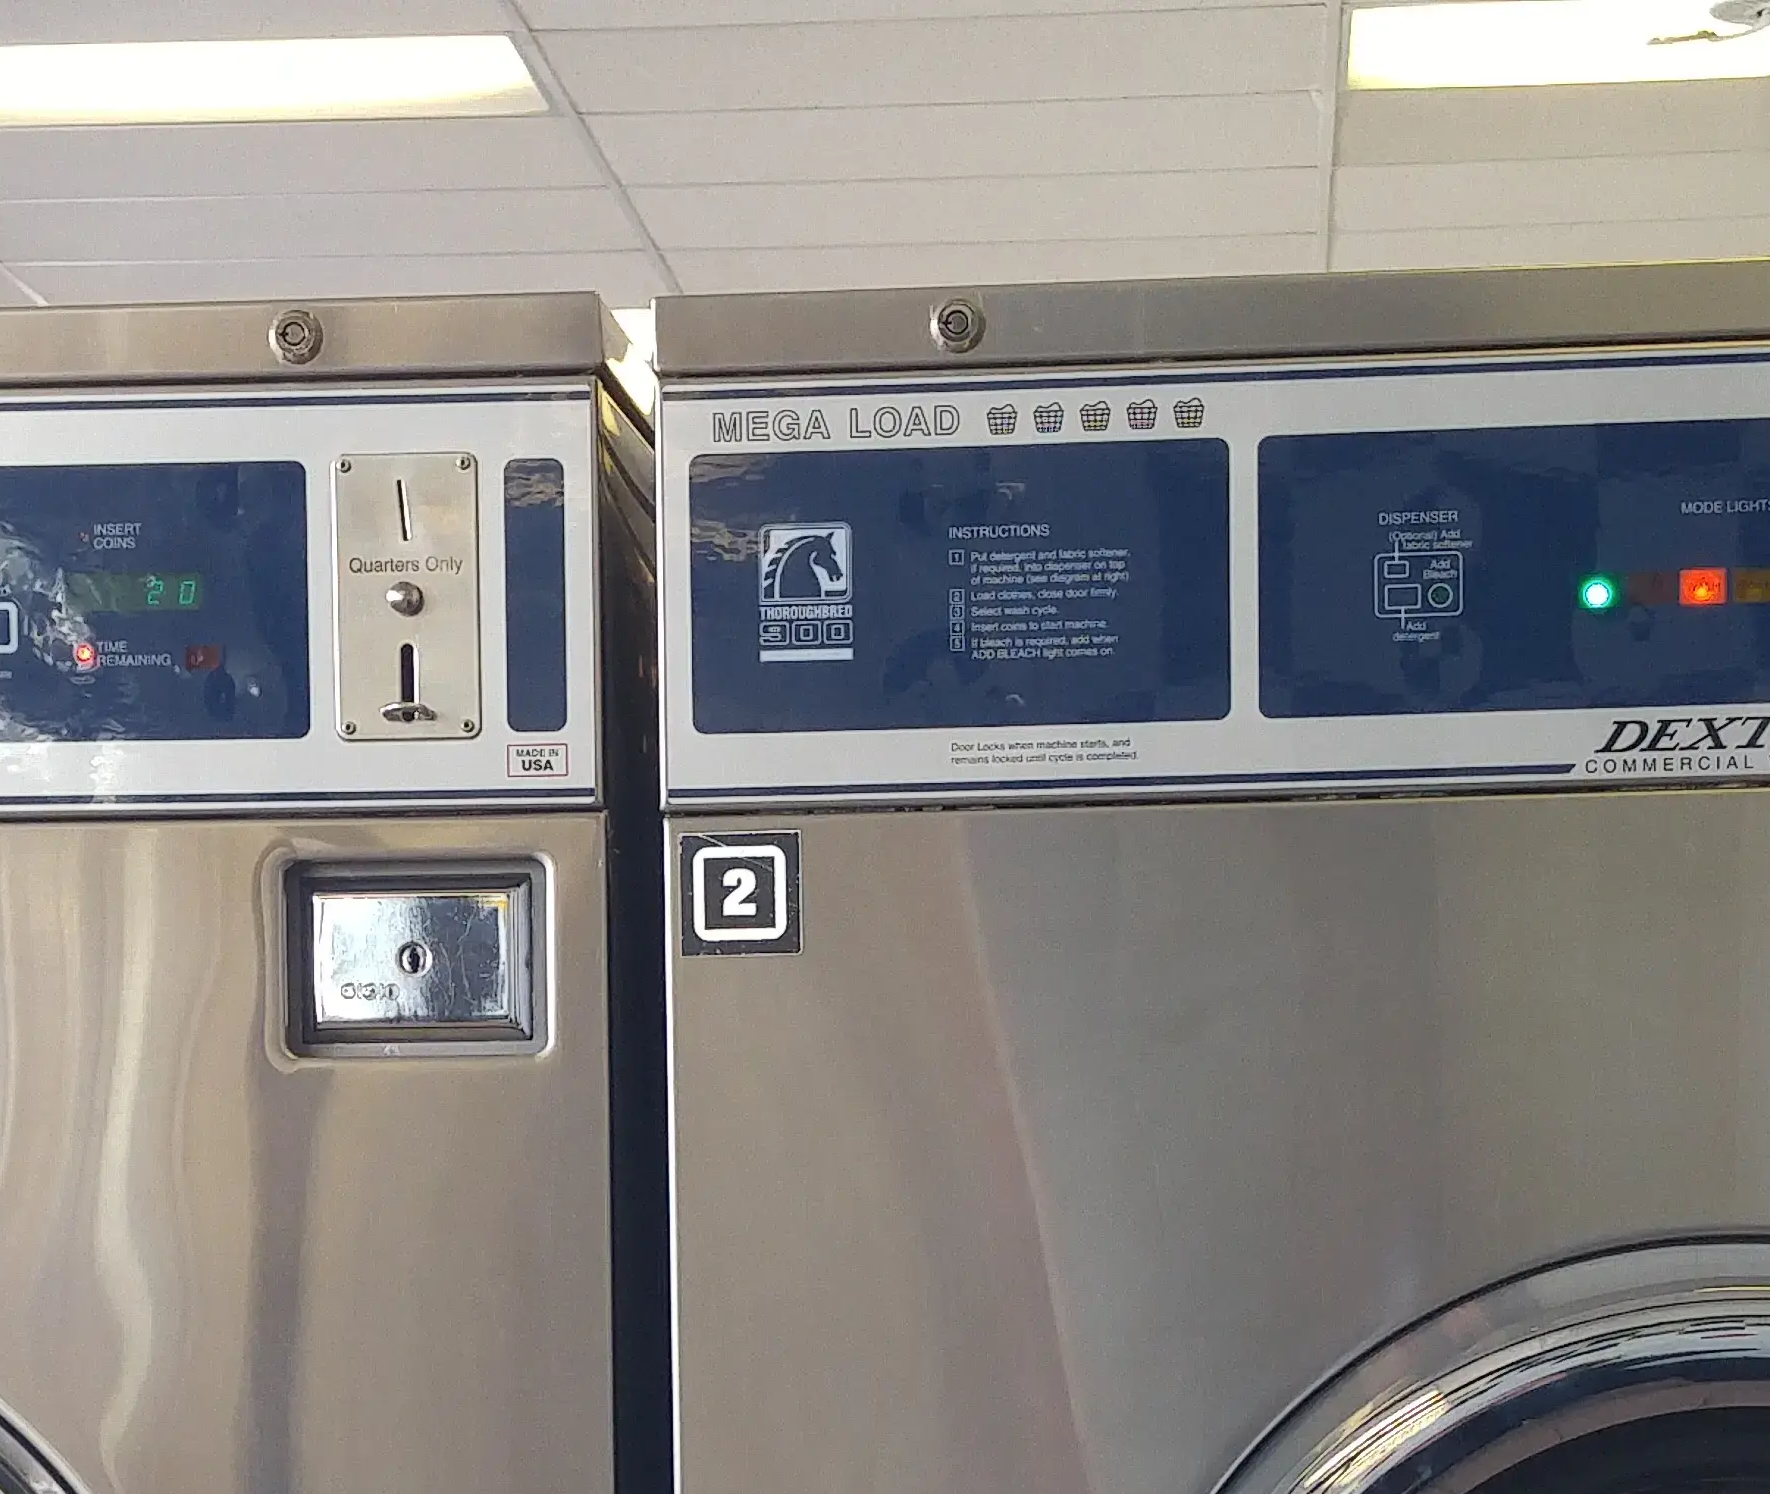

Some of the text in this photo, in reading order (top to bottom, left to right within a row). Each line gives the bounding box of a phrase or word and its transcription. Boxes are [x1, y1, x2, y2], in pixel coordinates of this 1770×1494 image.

[712, 404, 961, 443] MEGA LOAD
[1680, 501, 1722, 514] MODE
[1378, 511, 1459, 526] DISPENSER
[93, 522, 142, 537] INSERT
[948, 523, 1051, 540] INSTRUCTIONS
[1440, 528, 1461, 539] Add
[93, 536, 136, 550] COINS
[971, 551, 987, 562] Put
[1038, 551, 1057, 560] and
[349, 556, 463, 575] Quarters Only
[1093, 561, 1107, 570] on
[1430, 559, 1451, 570] Add
[971, 575, 981, 586] of
[982, 573, 1024, 585] machine
[971, 589, 1089, 601] Load close door
[759, 604, 853, 620] THOROUGHBRED
[971, 606, 1002, 617] Select
[971, 622, 999, 632] Insert
[1000, 622, 1027, 631] coins
[1028, 621, 1039, 631] to
[1407, 620, 1427, 631] Add
[97, 640, 128, 653] TIME
[980, 637, 1012, 648] bleach
[1014, 636, 1024, 647] is
[1071, 634, 1089, 644] add
[1091, 634, 1119, 644] when
[971, 648, 995, 659] ADD
[996, 647, 1041, 659] BLEACH
[1065, 647, 1098, 657] comes
[97, 653, 172, 667] REMAINING
[951, 742, 974, 752] Door
[977, 741, 1005, 751] Locks
[1037, 739, 1077, 749] machine
[1112, 737, 1130, 747] and
[516, 747, 560, 758] MADE IN
[951, 754, 989, 765] remains
[991, 753, 1023, 763] locked
[1048, 752, 1074, 764] cycle
[1076, 752, 1085, 761] is
[521, 758, 554, 773] USA
[1585, 754, 1755, 775] COMMERCIAL
[720, 867, 759, 918] 2
